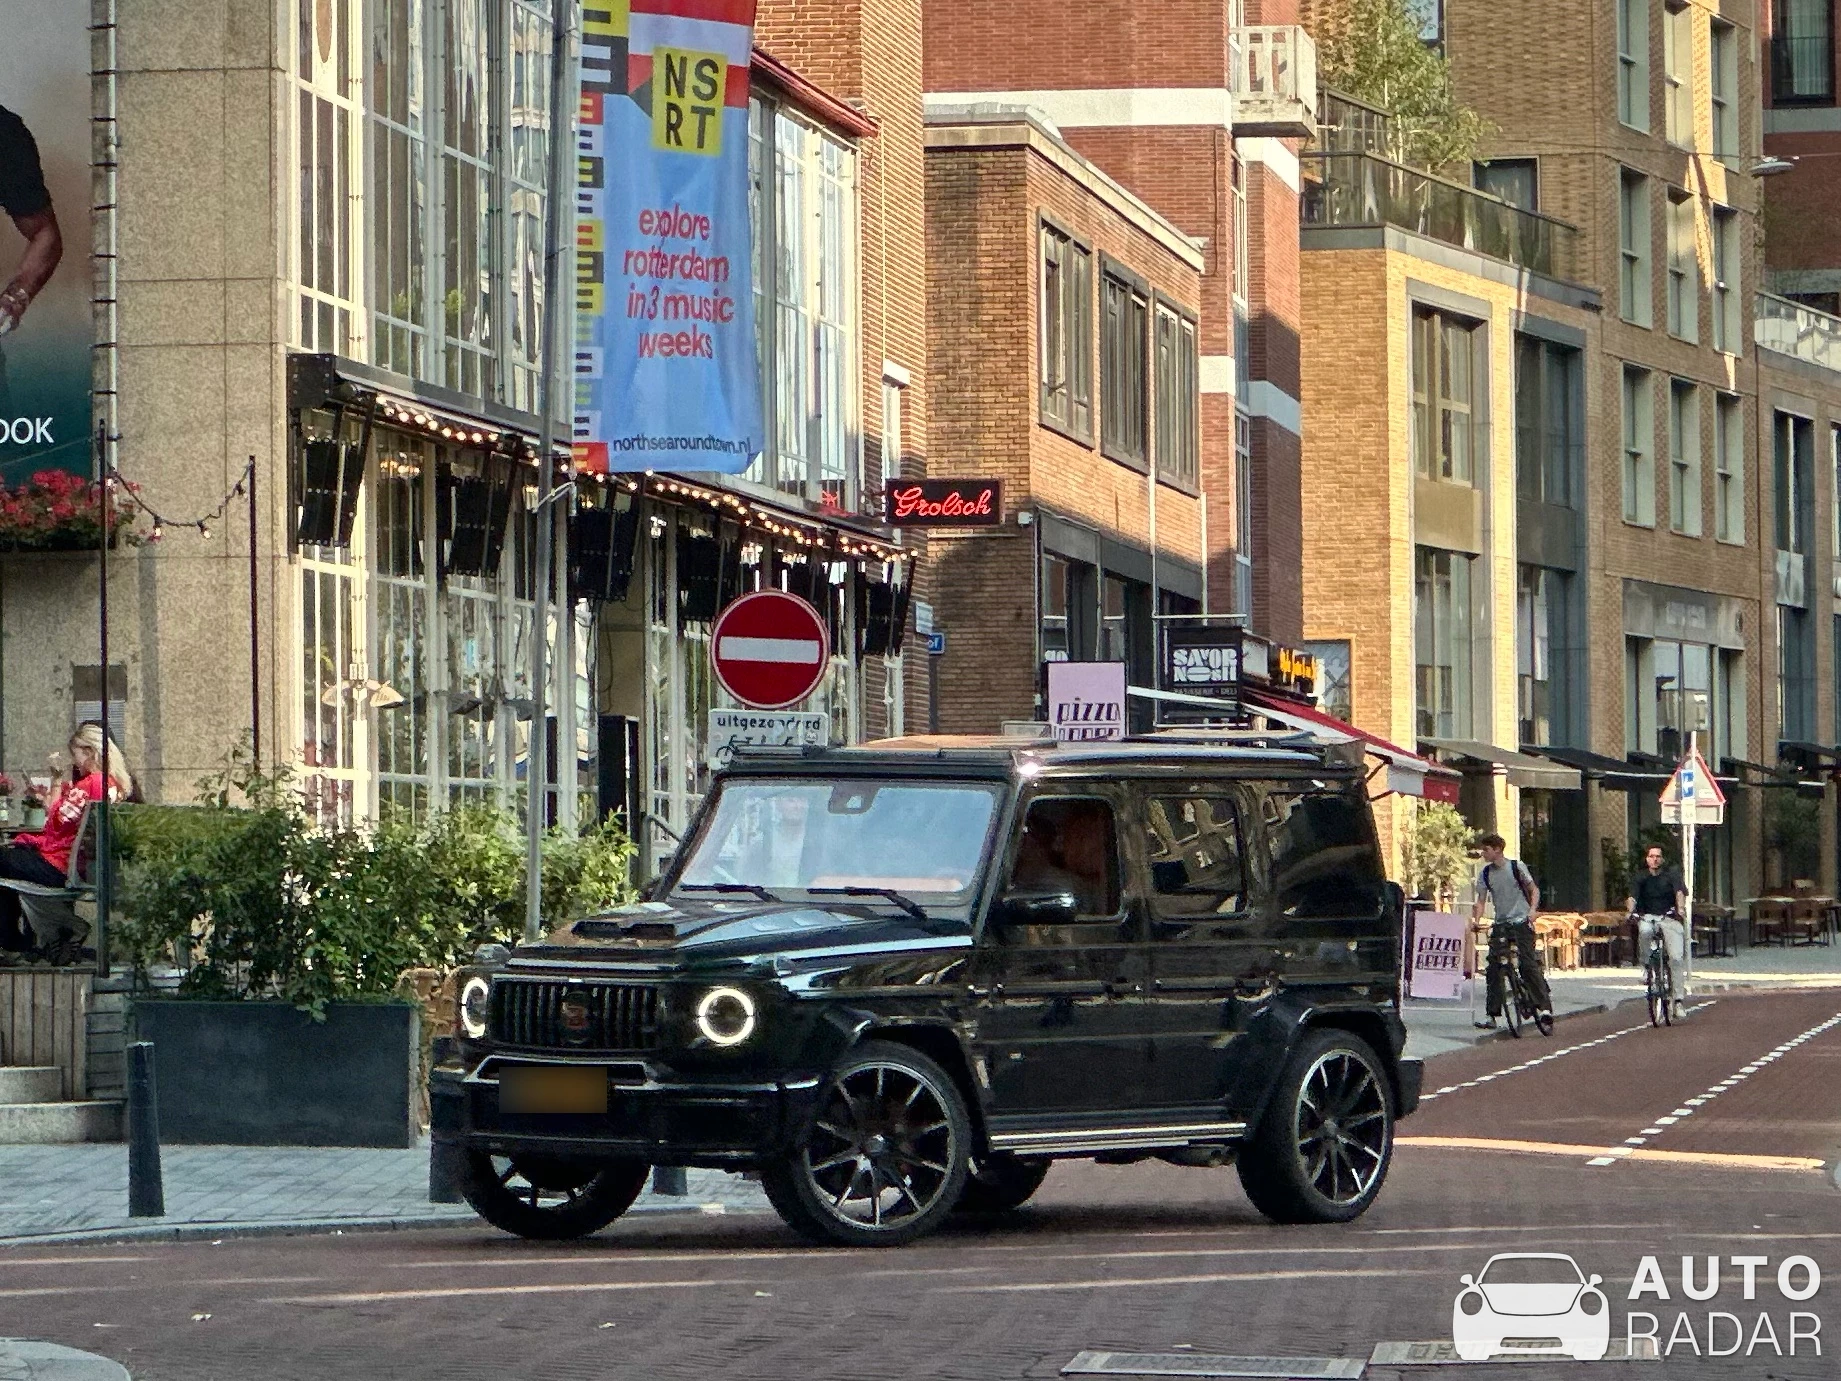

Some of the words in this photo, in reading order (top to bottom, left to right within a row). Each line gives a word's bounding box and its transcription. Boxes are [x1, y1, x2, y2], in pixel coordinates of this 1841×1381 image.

[665, 53, 719, 101] NS
[665, 102, 716, 149] RT
[638, 203, 711, 247] explore
[623, 245, 730, 283] rotterdam
[663, 287, 735, 324] music
[638, 323, 713, 359] weeks
[613, 432, 752, 455] northsearoundtown.nl
[893, 486, 993, 518] Grolsch
[1173, 648, 1237, 668] SAVOR
